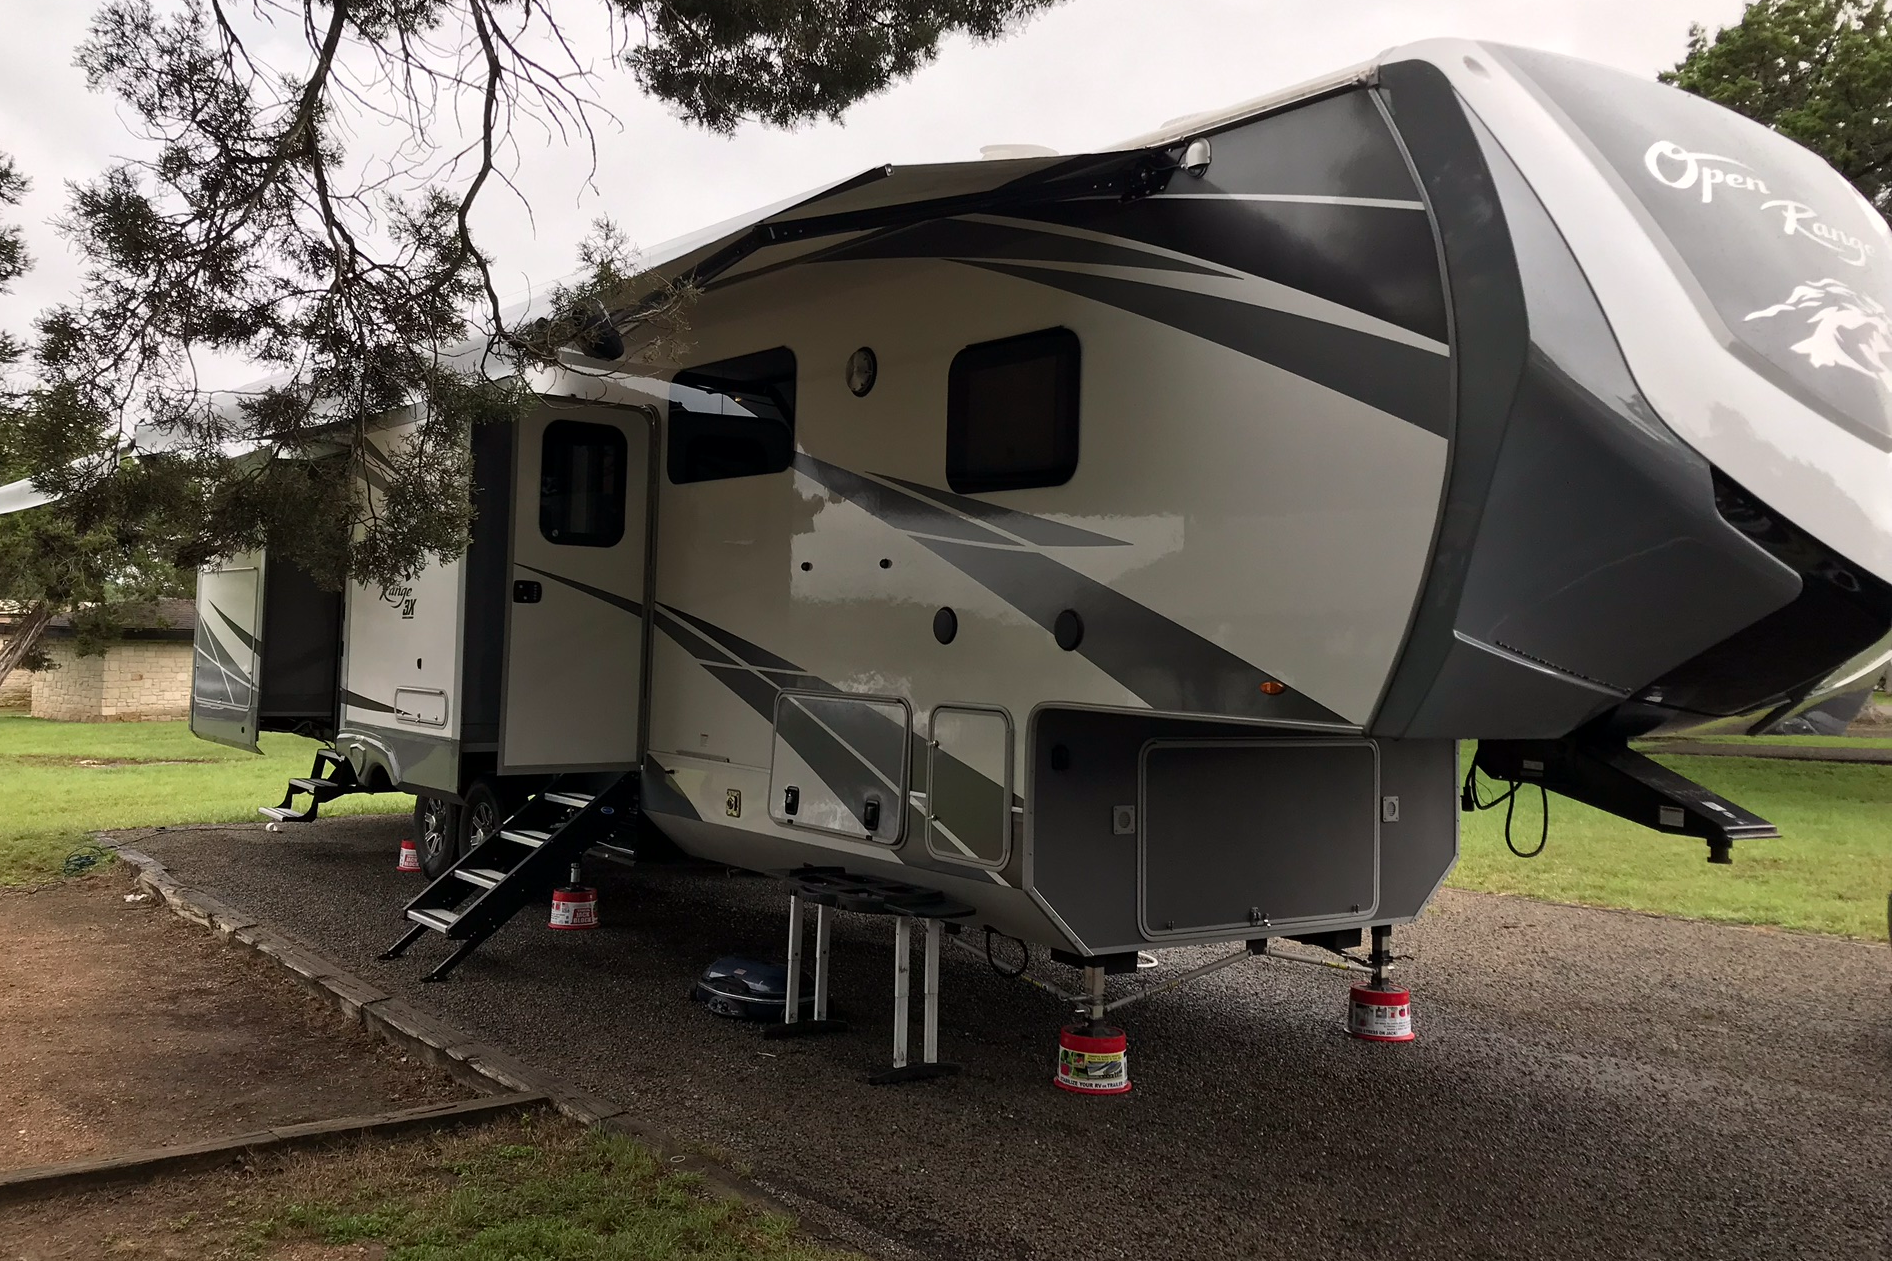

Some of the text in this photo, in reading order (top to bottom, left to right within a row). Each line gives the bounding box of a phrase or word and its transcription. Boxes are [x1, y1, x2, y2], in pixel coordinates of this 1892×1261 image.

[1645, 140, 1771, 203] Open
[1760, 200, 1876, 267] Range
[403, 599, 417, 615] 3X
